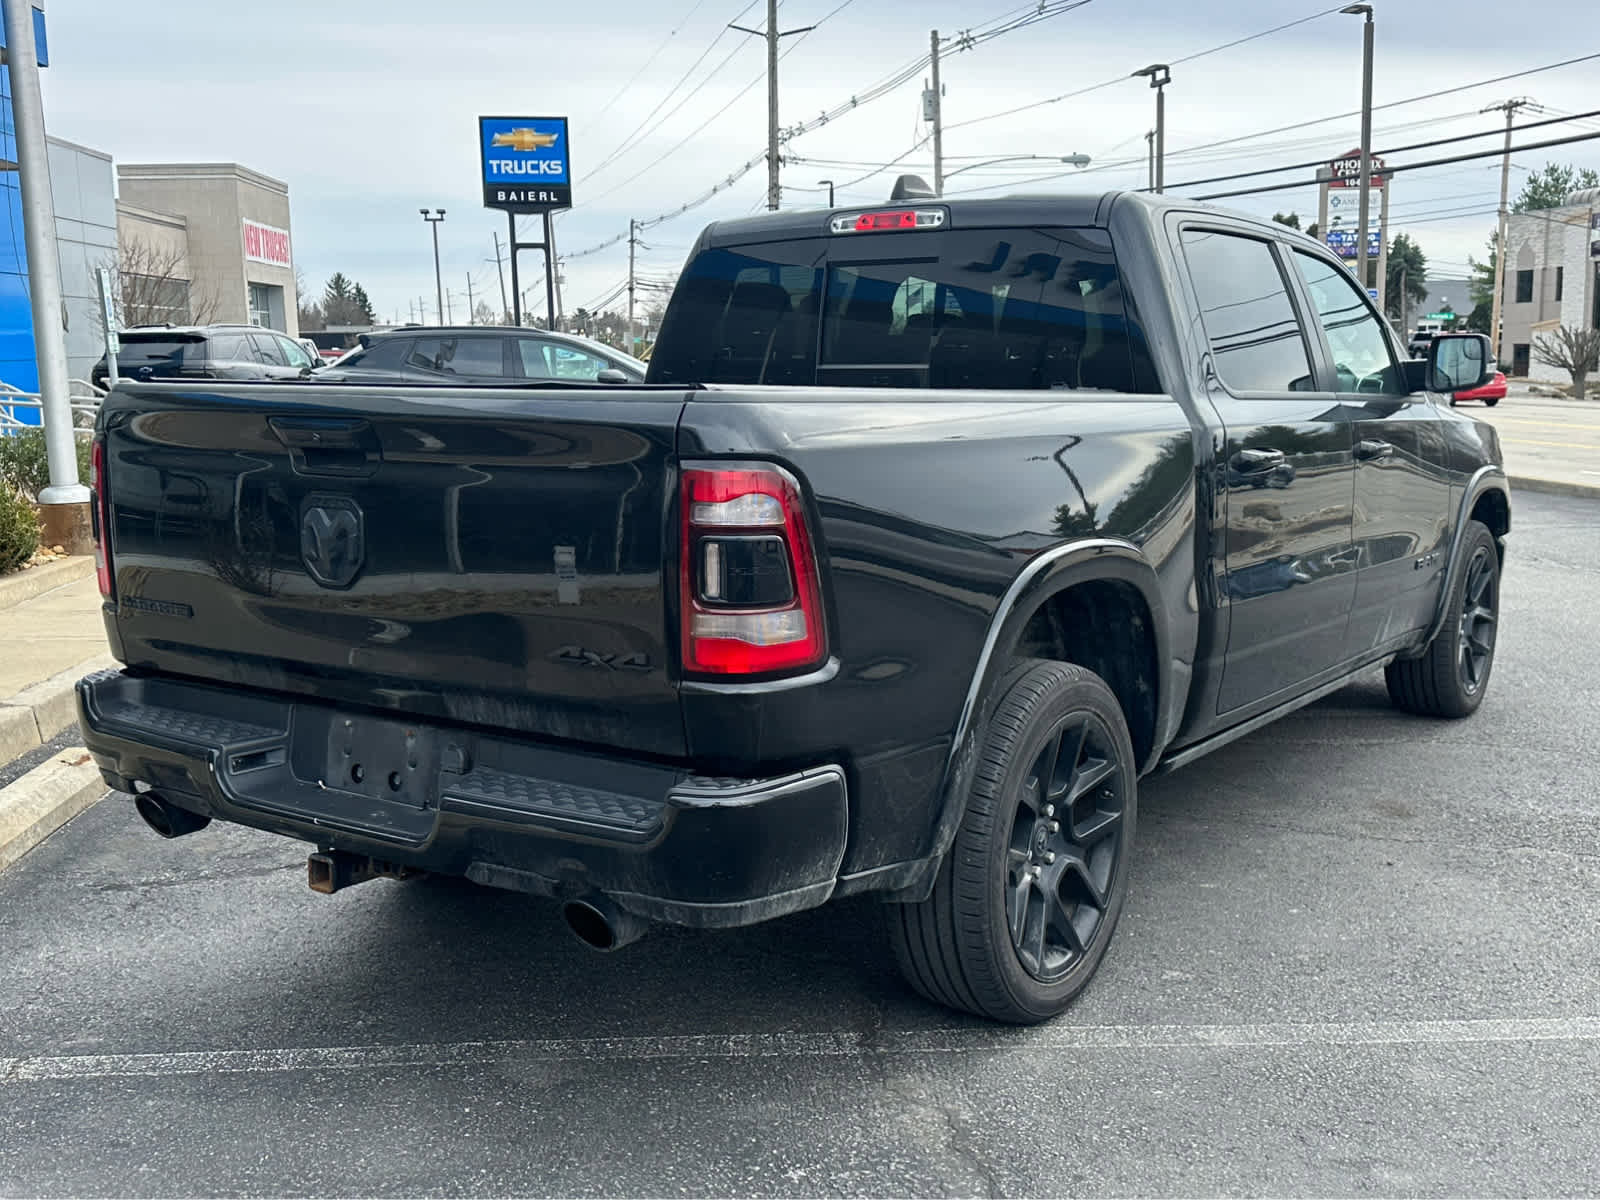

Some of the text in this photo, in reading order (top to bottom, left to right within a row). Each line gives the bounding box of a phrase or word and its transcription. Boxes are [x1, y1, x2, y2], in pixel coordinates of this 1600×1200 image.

[488, 159, 563, 174] TRUCKS
[497, 191, 558, 201] BAIERL
[244, 223, 290, 265] NEW TRUCKS!
